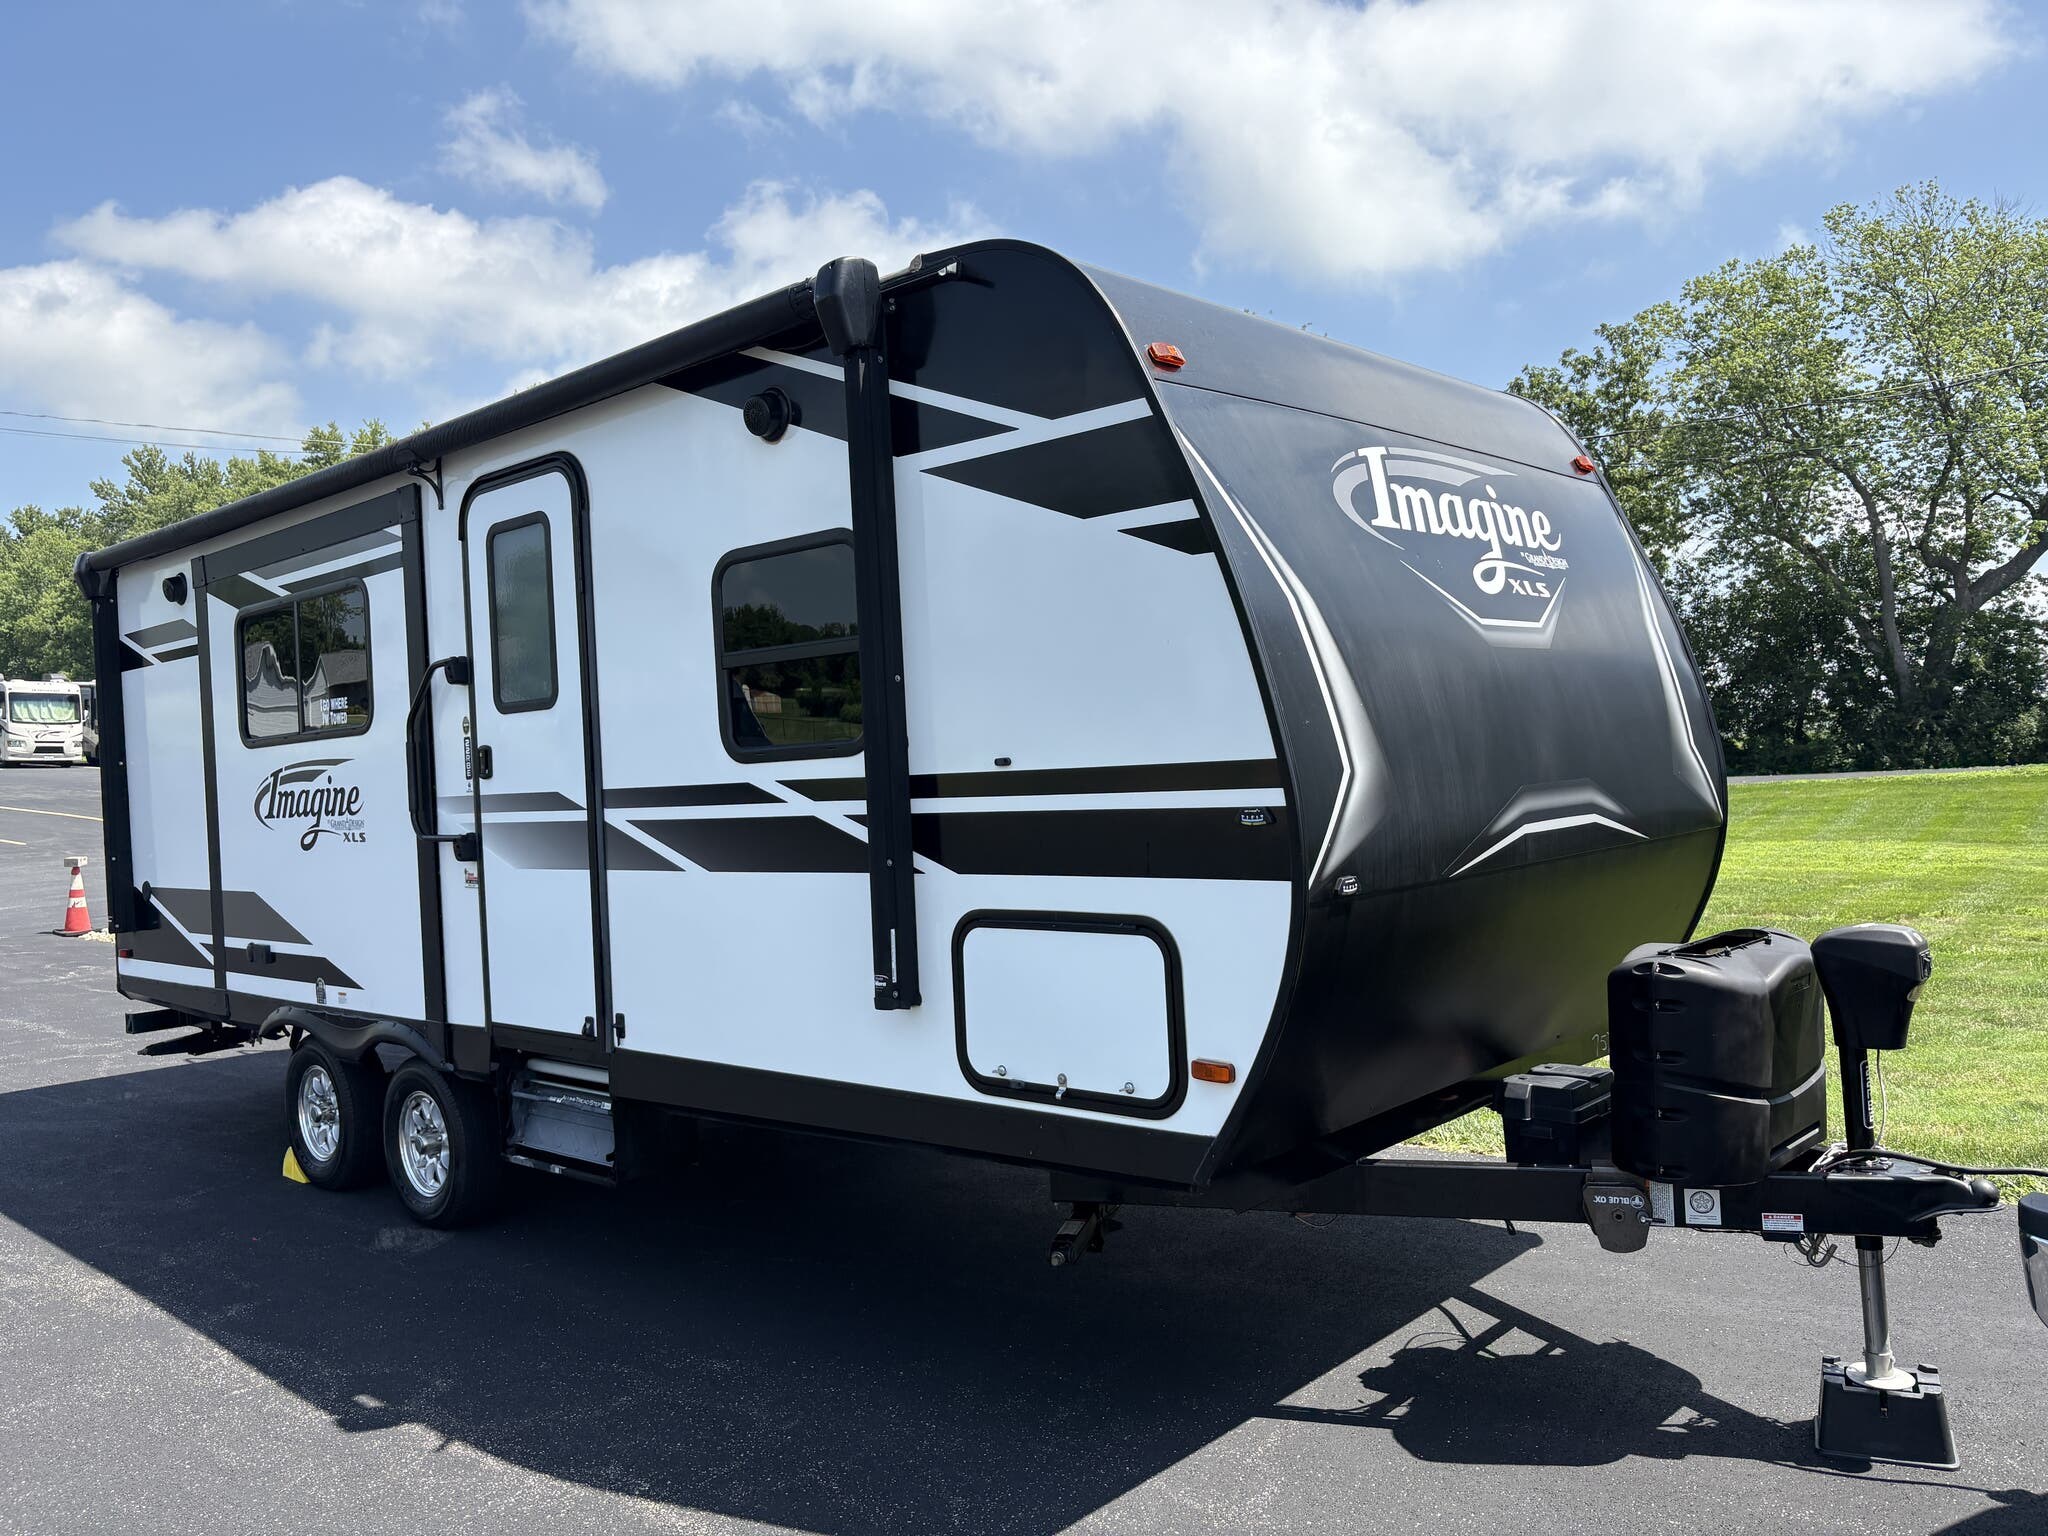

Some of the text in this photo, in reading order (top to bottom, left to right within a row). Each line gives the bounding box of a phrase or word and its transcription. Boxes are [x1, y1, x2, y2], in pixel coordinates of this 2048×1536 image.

[1357, 446, 1562, 595] Imagine
[1508, 579, 1551, 598] XLS
[264, 767, 365, 851] Imagine
[343, 832, 366, 842] XLS
[1593, 1195, 1630, 1205] BLUE OX
